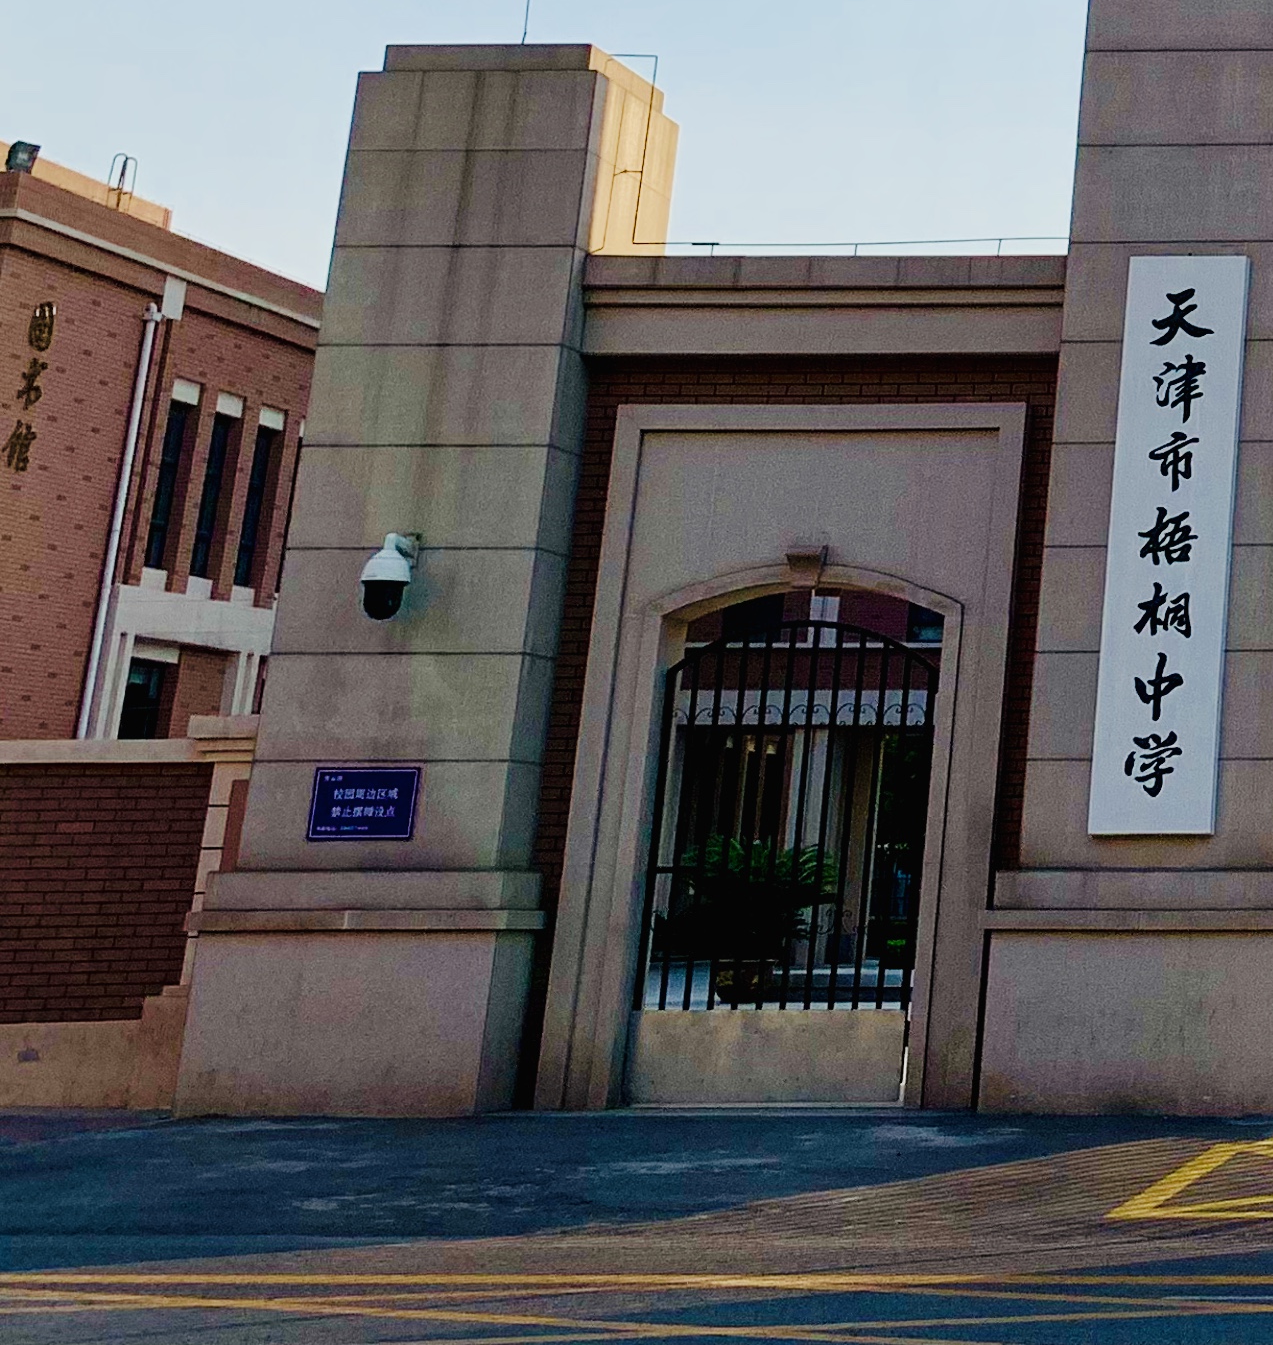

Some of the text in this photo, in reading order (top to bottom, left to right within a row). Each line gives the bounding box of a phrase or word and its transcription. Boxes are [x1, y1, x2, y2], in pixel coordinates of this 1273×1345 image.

[2, 301, 56, 473] 图书馆
[1124, 287, 1215, 798] 天津市梧桐中学
